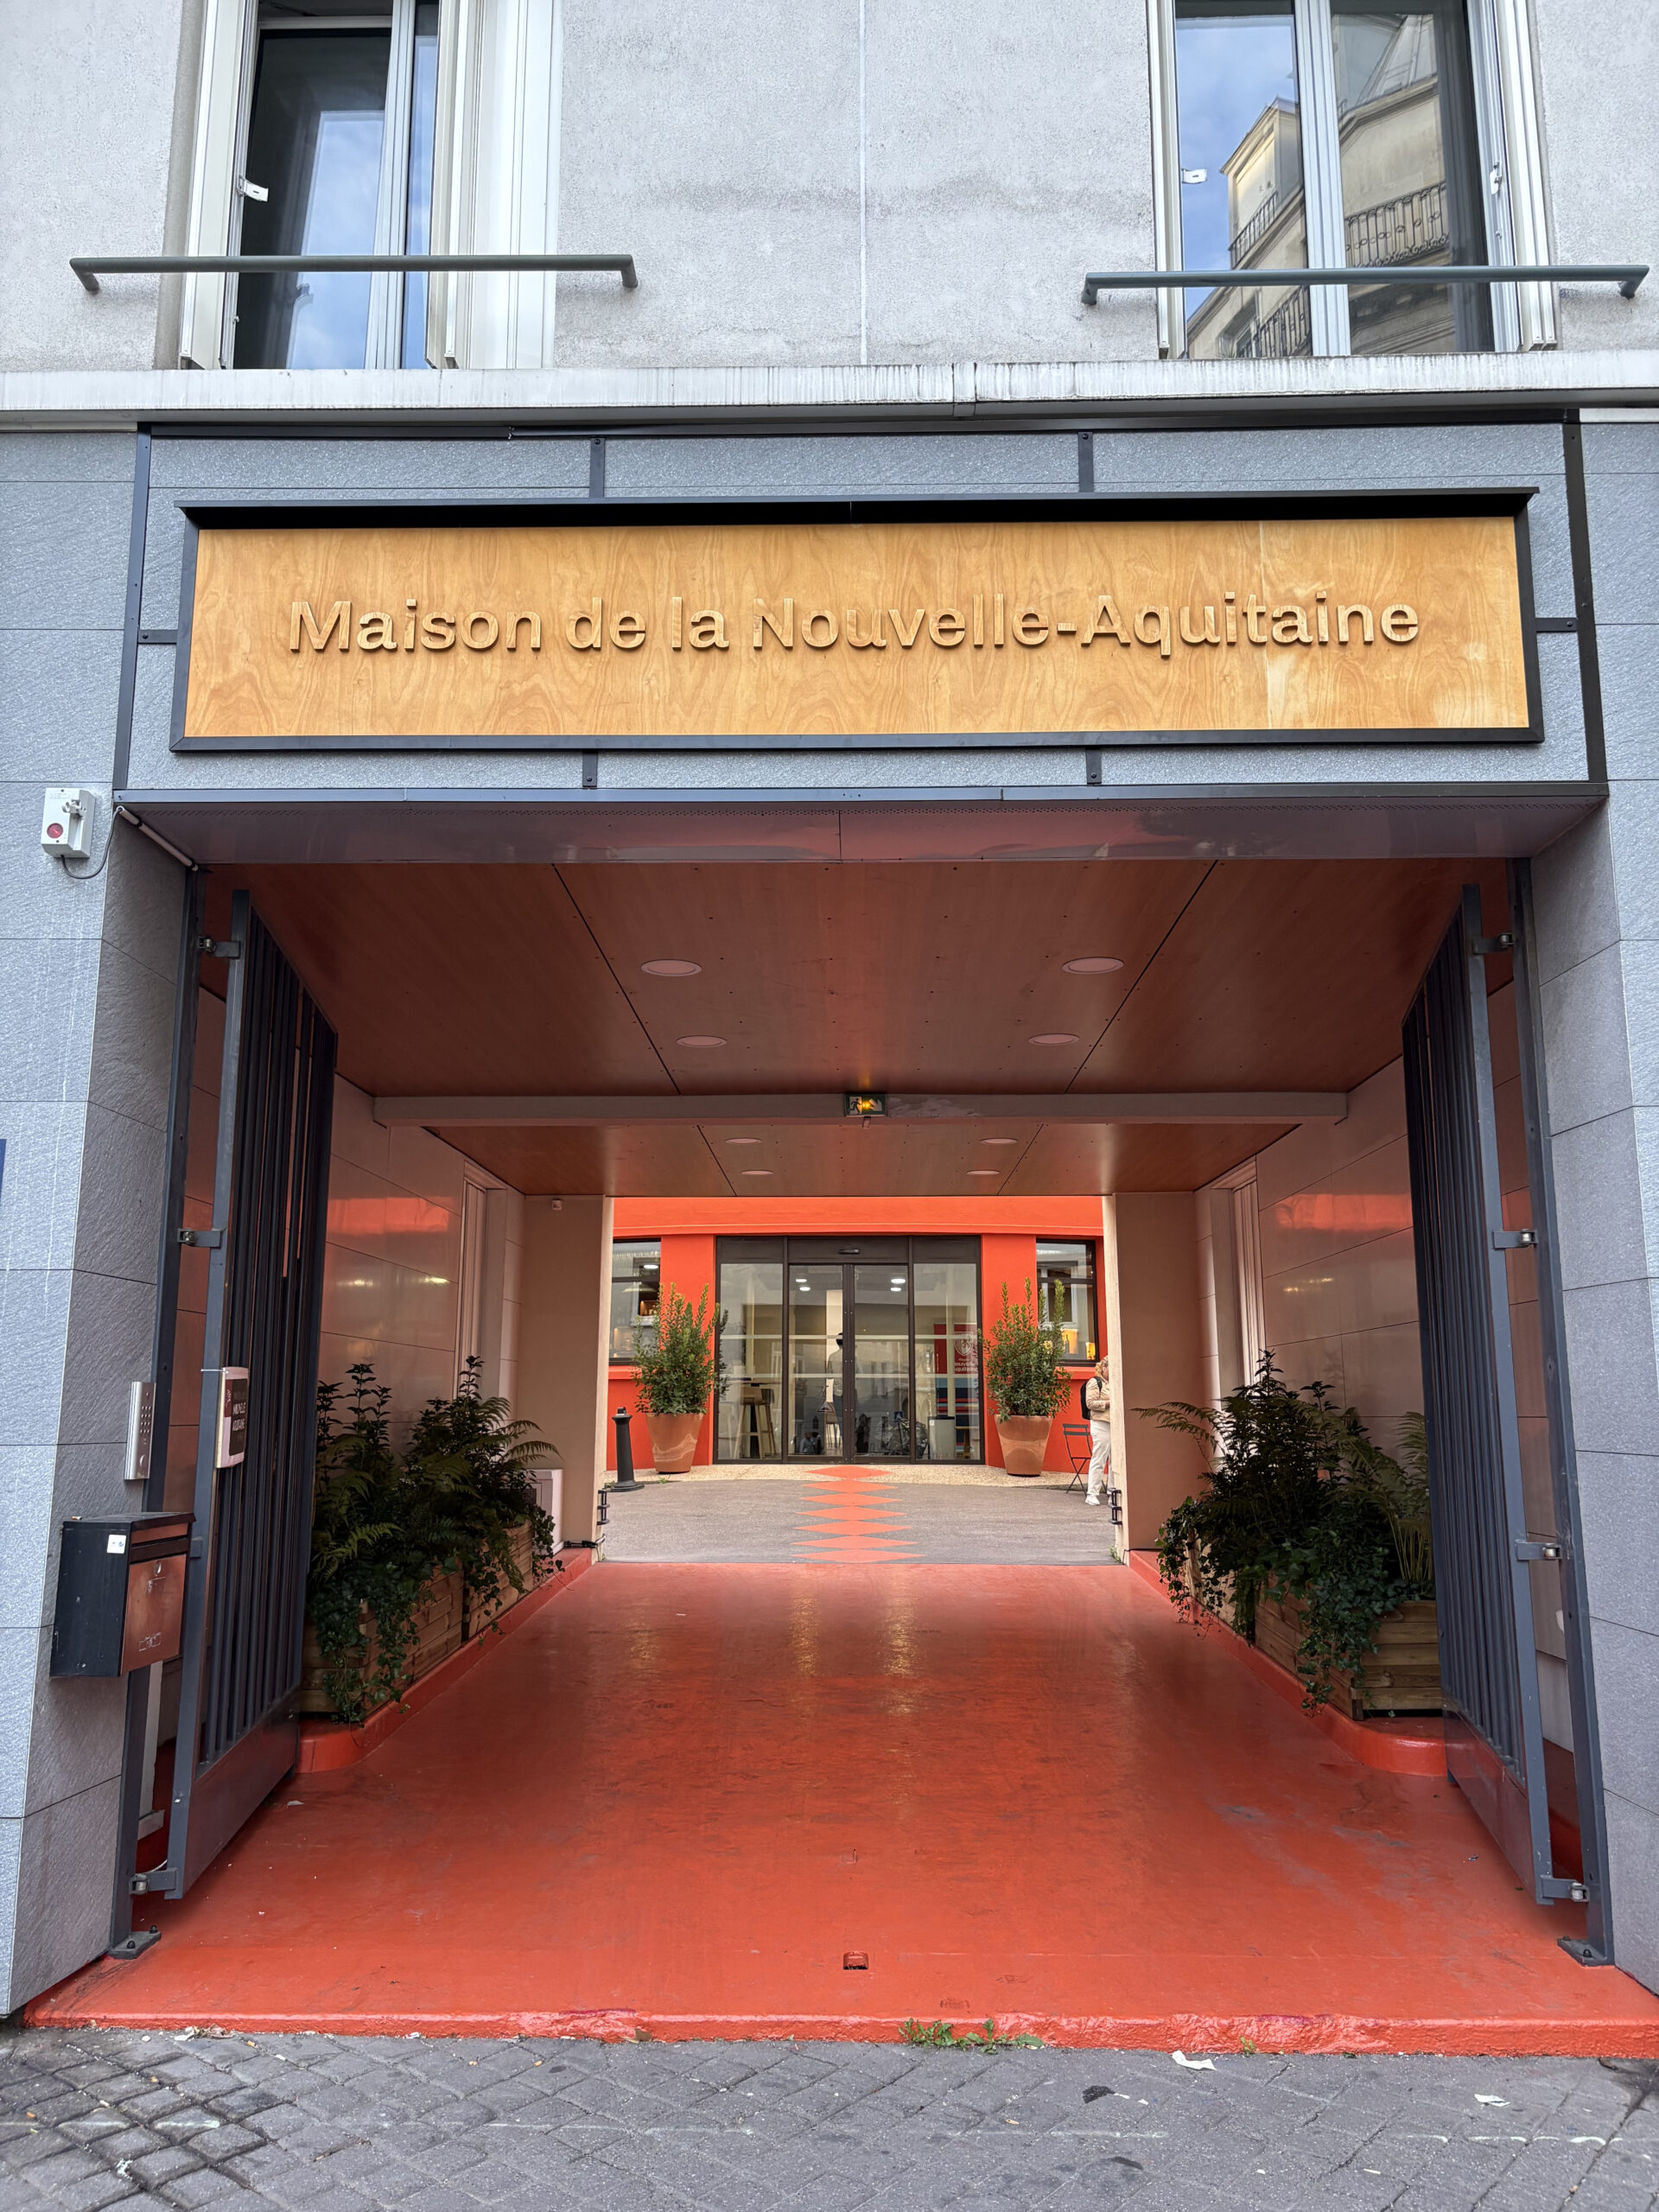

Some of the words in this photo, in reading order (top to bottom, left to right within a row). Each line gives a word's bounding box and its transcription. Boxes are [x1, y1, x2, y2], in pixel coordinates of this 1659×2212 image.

[289, 598, 542, 653] Maison
[565, 597, 647, 651] de
[671, 595, 729, 651] la
[752, 590, 1420, 659] Nouvelle-Aquitaine
